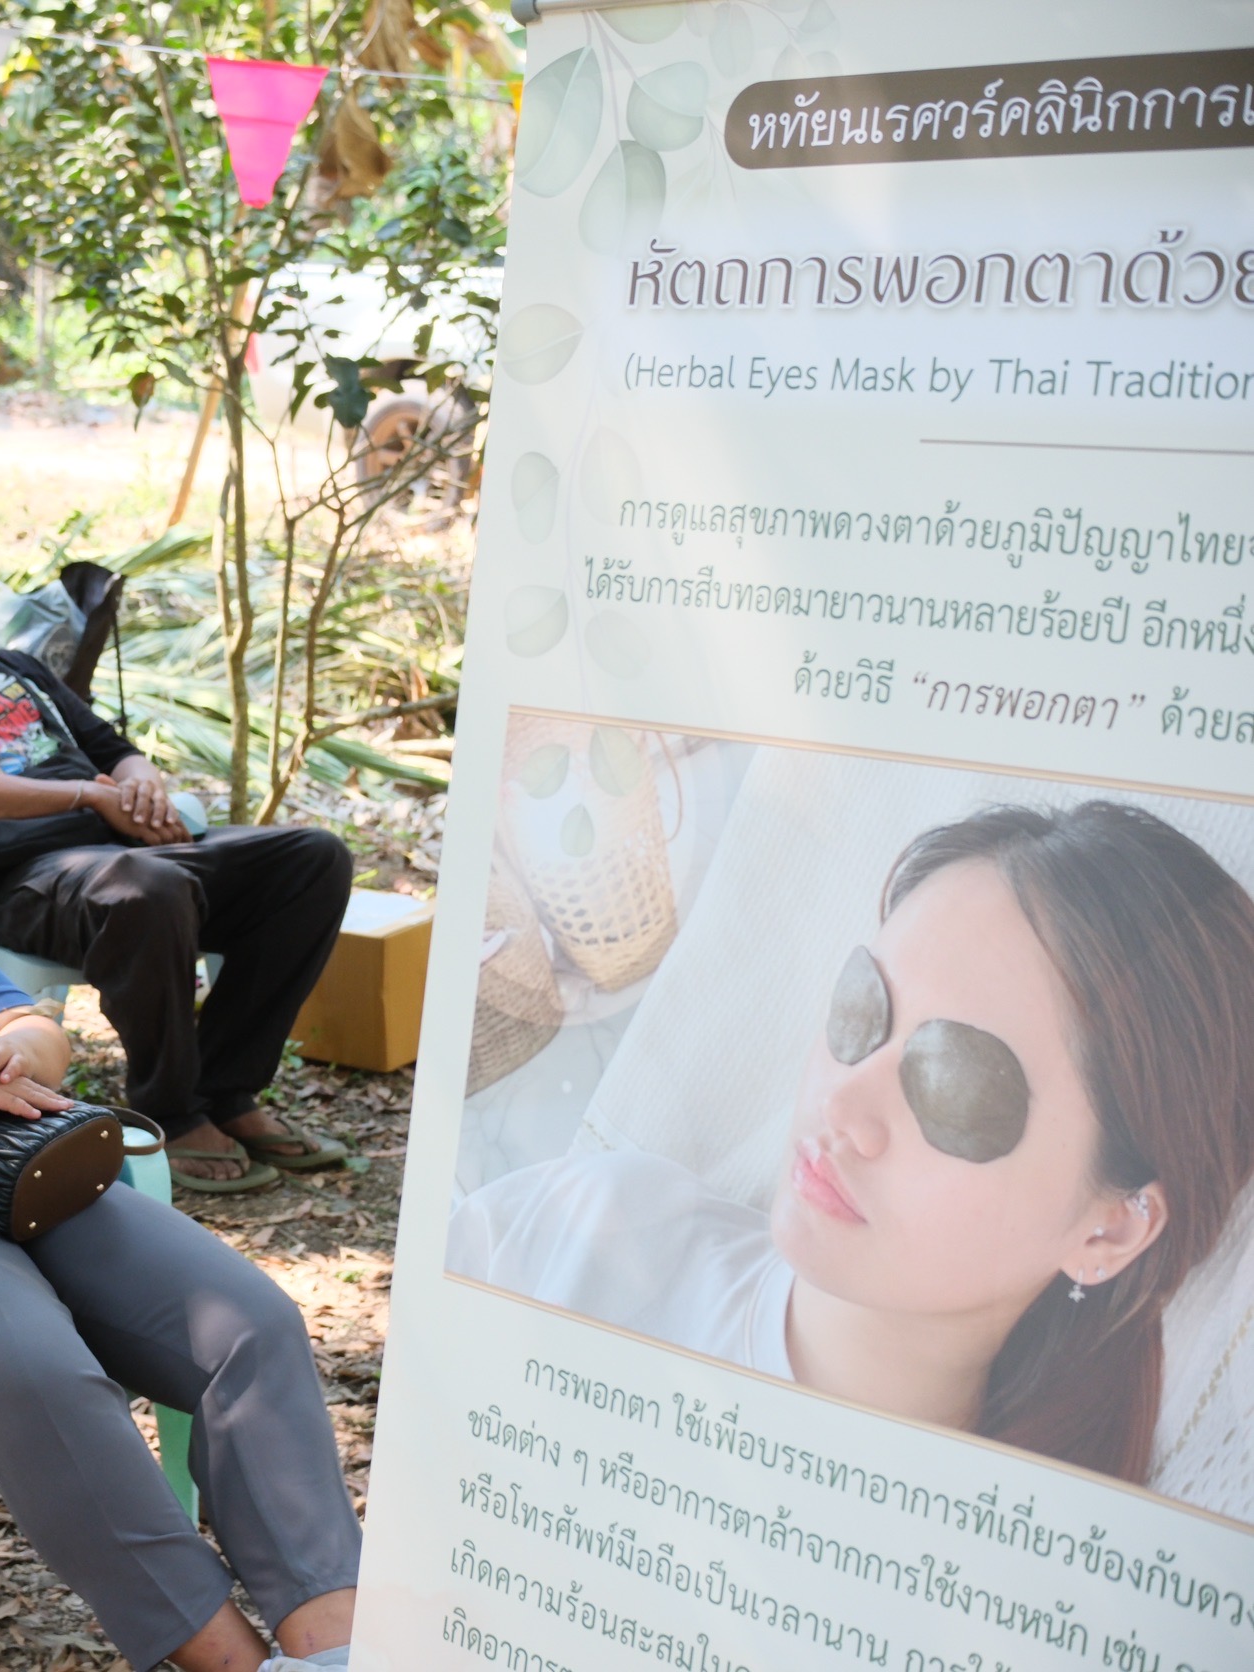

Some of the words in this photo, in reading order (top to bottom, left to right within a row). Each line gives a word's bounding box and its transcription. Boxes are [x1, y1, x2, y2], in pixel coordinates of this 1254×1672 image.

[624, 352, 736, 391] (Herbal
[747, 356, 818, 398] Eyes
[830, 356, 915, 393] Mask
[929, 356, 974, 402] by
[989, 357, 1071, 396] Thai
[619, 499, 1254, 575] การดูแลสุขภาพดวงตาด้วยภูมิปัญญาไทย
[584, 555, 1130, 644] ได้รับการสืบทอดมายาวนานหลายร้อยปี
[794, 649, 895, 704] ด้วยวิธี
[524, 1358, 661, 1429] การพอกตา
[467, 1404, 561, 1468] ชนิดต่าง
[599, 1450, 1088, 1658] หรืออาการตาล้าจากการใช้งานหนัก
[459, 1472, 888, 1668] หรือโทรศัพท์มือถือเป็นเวลานาน
